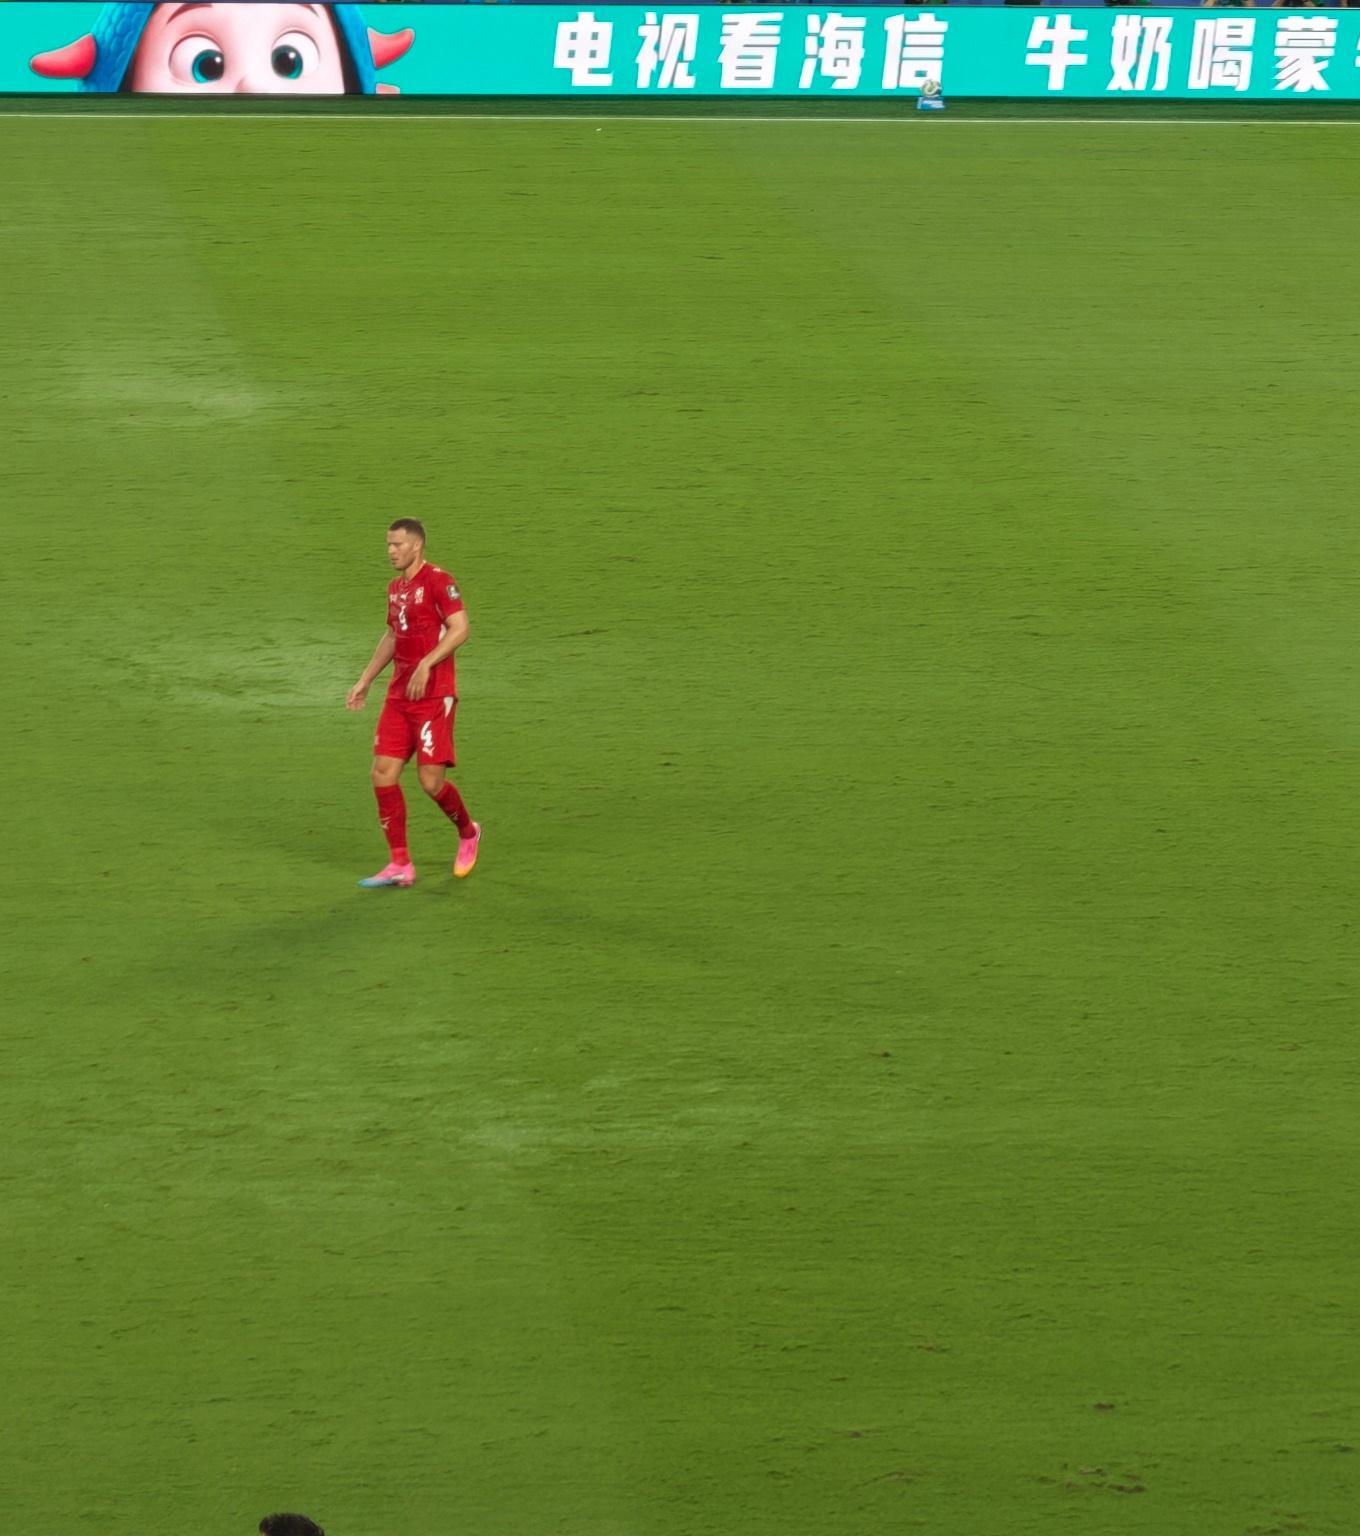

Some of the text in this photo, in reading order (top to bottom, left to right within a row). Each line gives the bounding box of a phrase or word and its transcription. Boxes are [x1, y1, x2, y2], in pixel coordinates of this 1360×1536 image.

[553, 11, 949, 90] 电视看海信
[420, 720, 433, 747] 4
